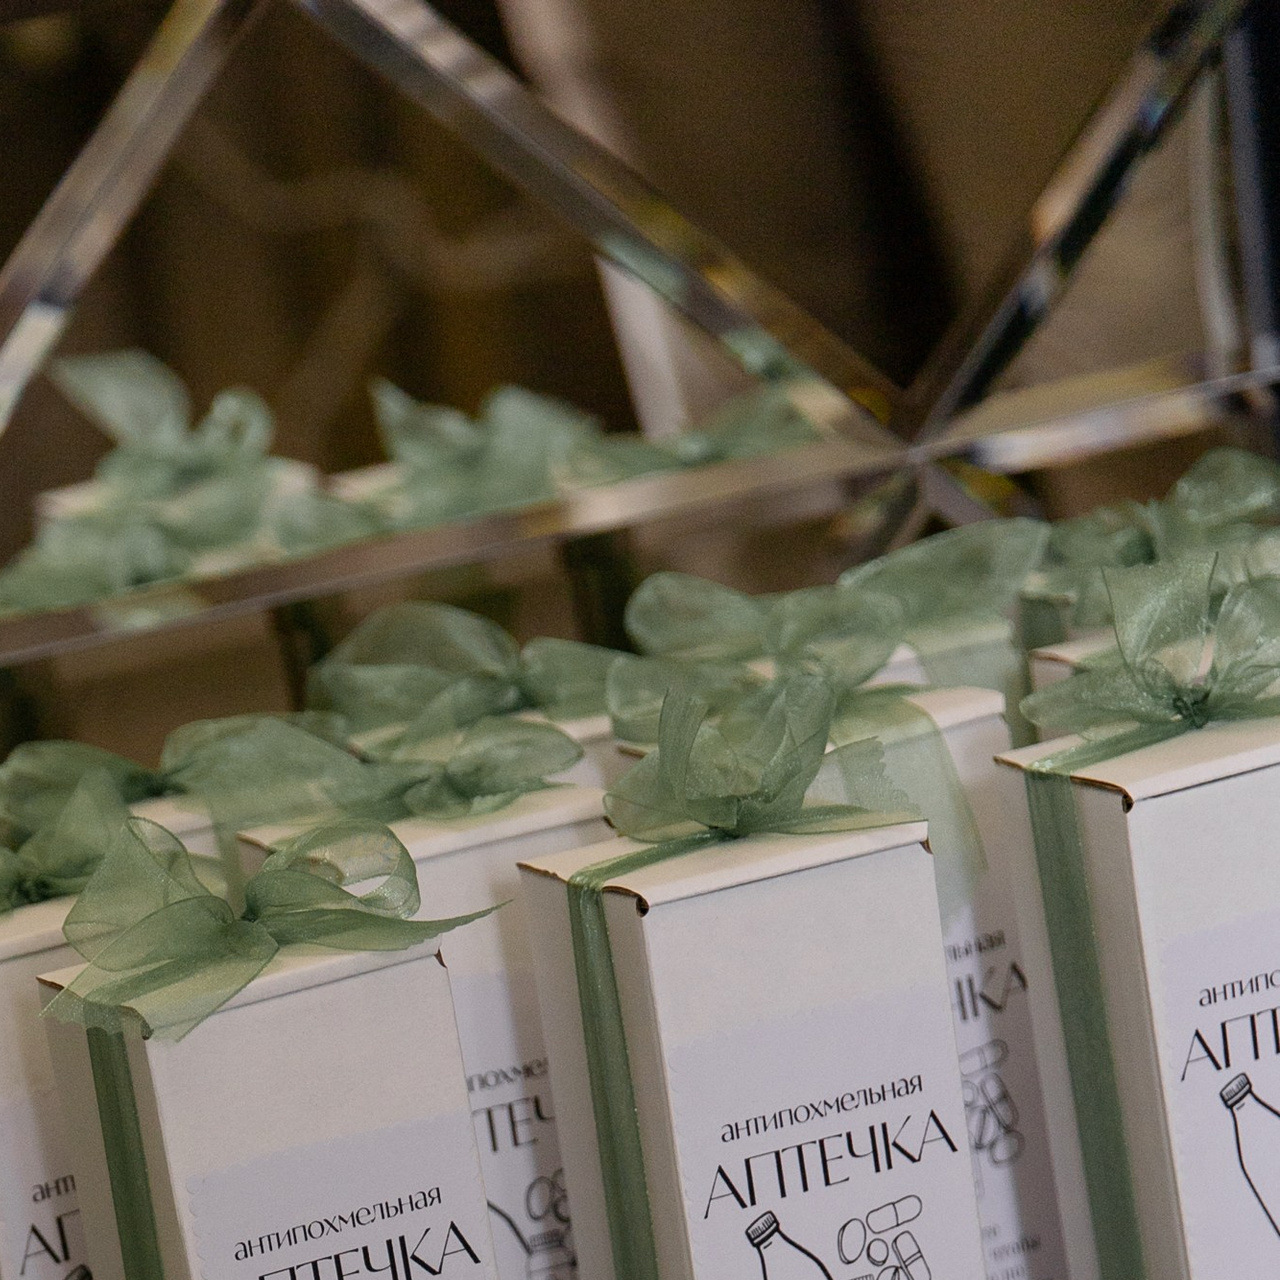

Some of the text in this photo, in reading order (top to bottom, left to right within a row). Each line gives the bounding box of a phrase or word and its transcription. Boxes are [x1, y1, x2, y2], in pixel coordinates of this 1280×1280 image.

[720, 1073, 923, 1143] антипохмельная
[703, 1108, 958, 1219] АПТЕЧКА
[233, 1186, 442, 1261] антипохмельная
